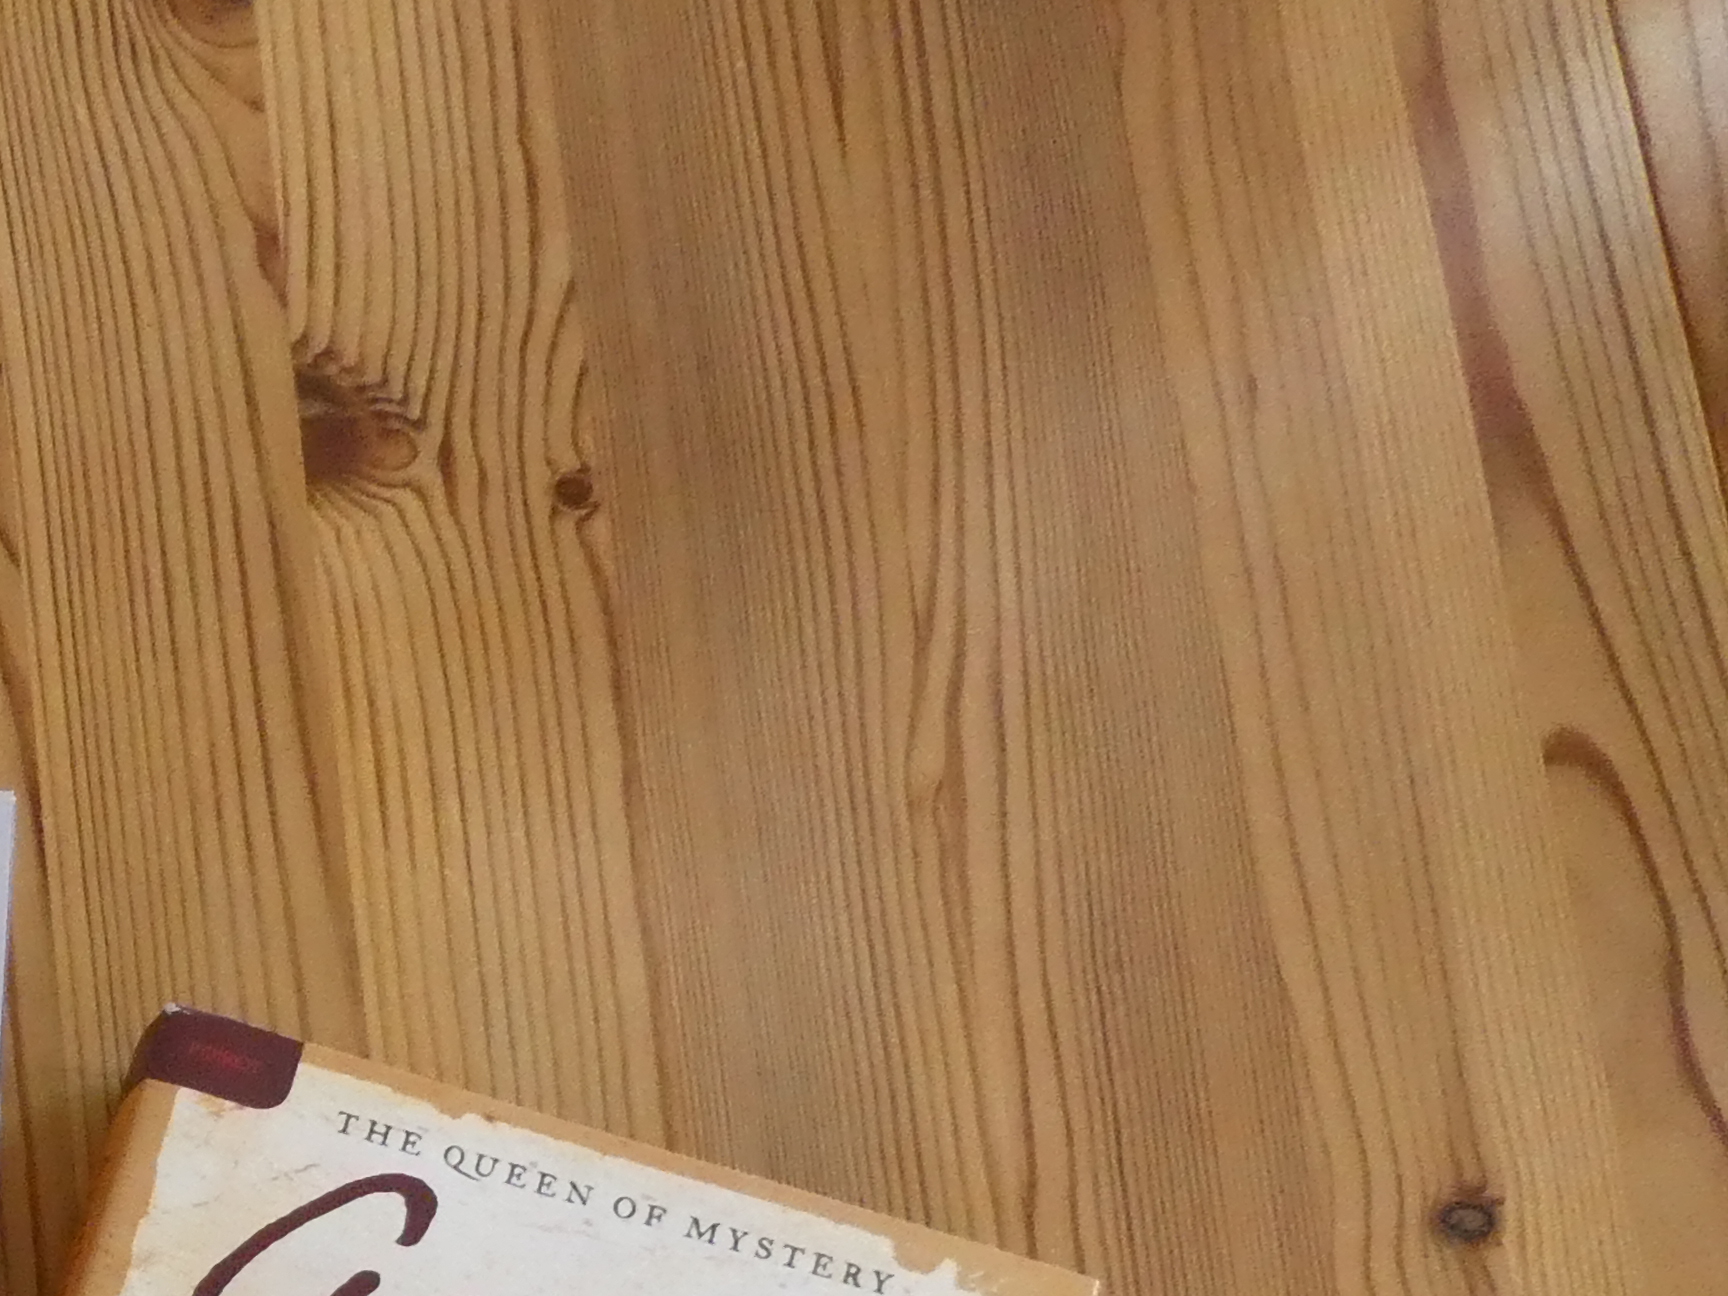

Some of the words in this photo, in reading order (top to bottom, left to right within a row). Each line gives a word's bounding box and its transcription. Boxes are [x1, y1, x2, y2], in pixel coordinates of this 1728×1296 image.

[336, 1108, 423, 1158] THE
[443, 1141, 592, 1209] QUEEN
[612, 1195, 668, 1229] OF
